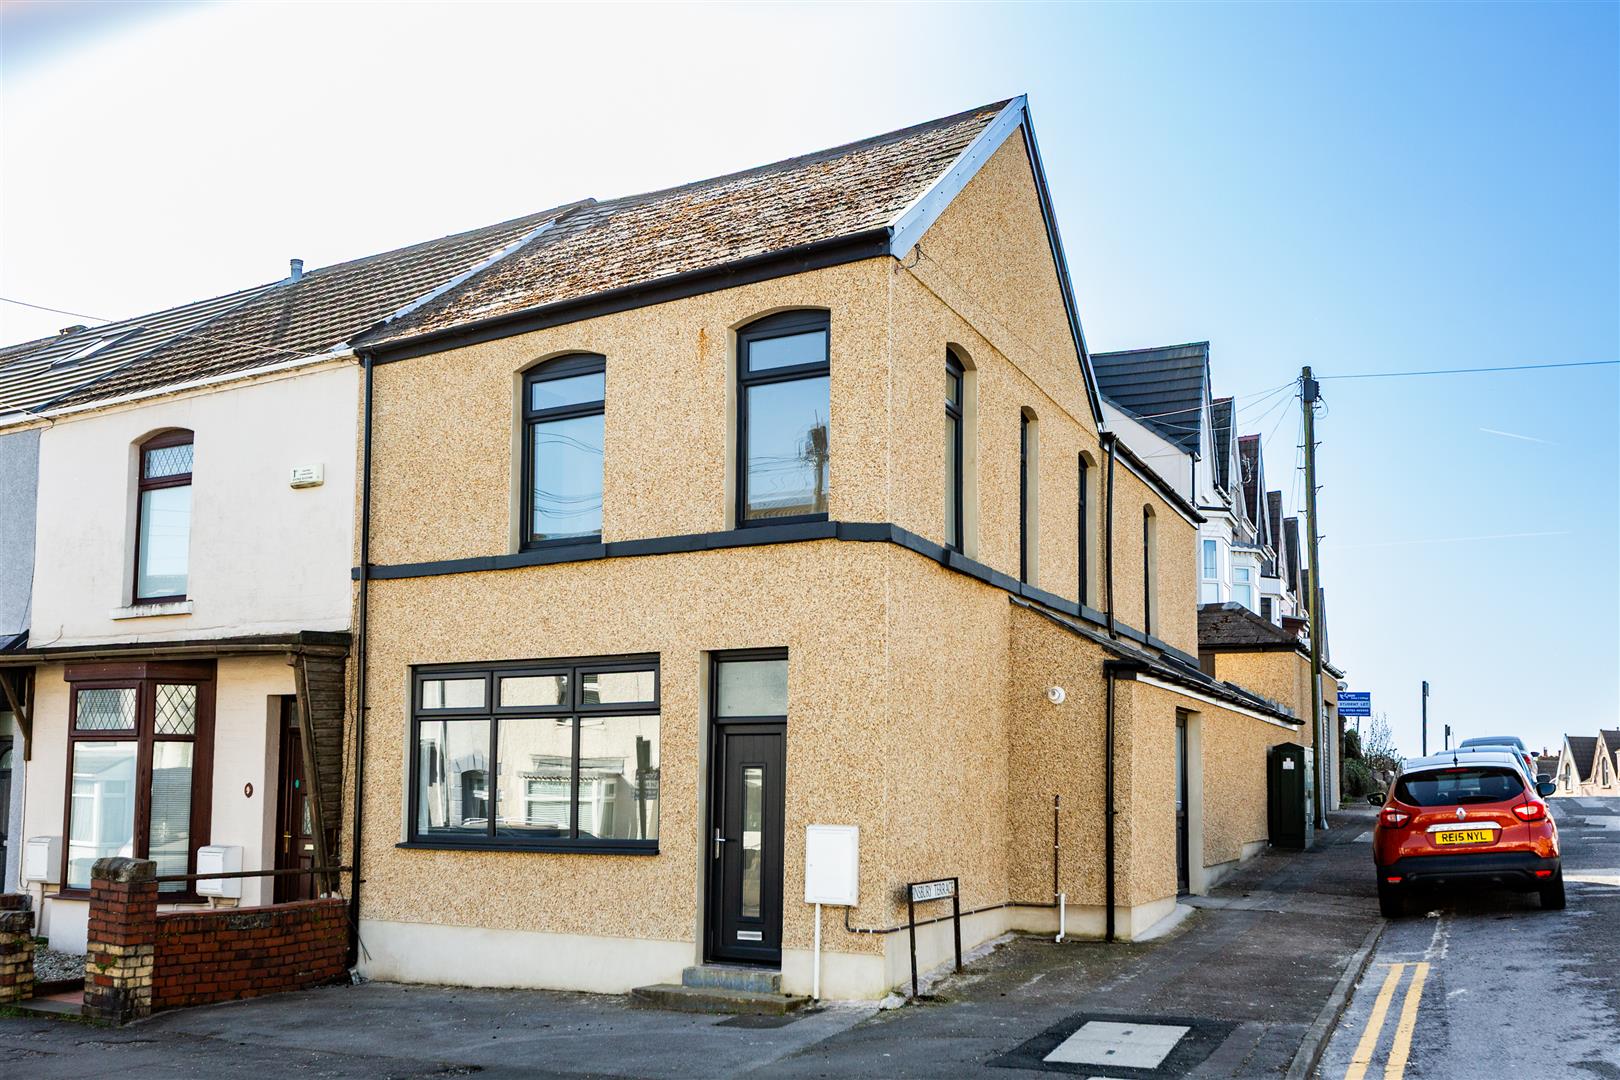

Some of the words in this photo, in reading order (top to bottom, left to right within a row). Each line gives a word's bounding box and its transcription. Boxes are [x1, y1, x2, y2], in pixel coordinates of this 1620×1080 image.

[1441, 832, 1465, 843] RE15
[1466, 831, 1488, 841] NYL
[933, 881, 954, 896] TERRACE
